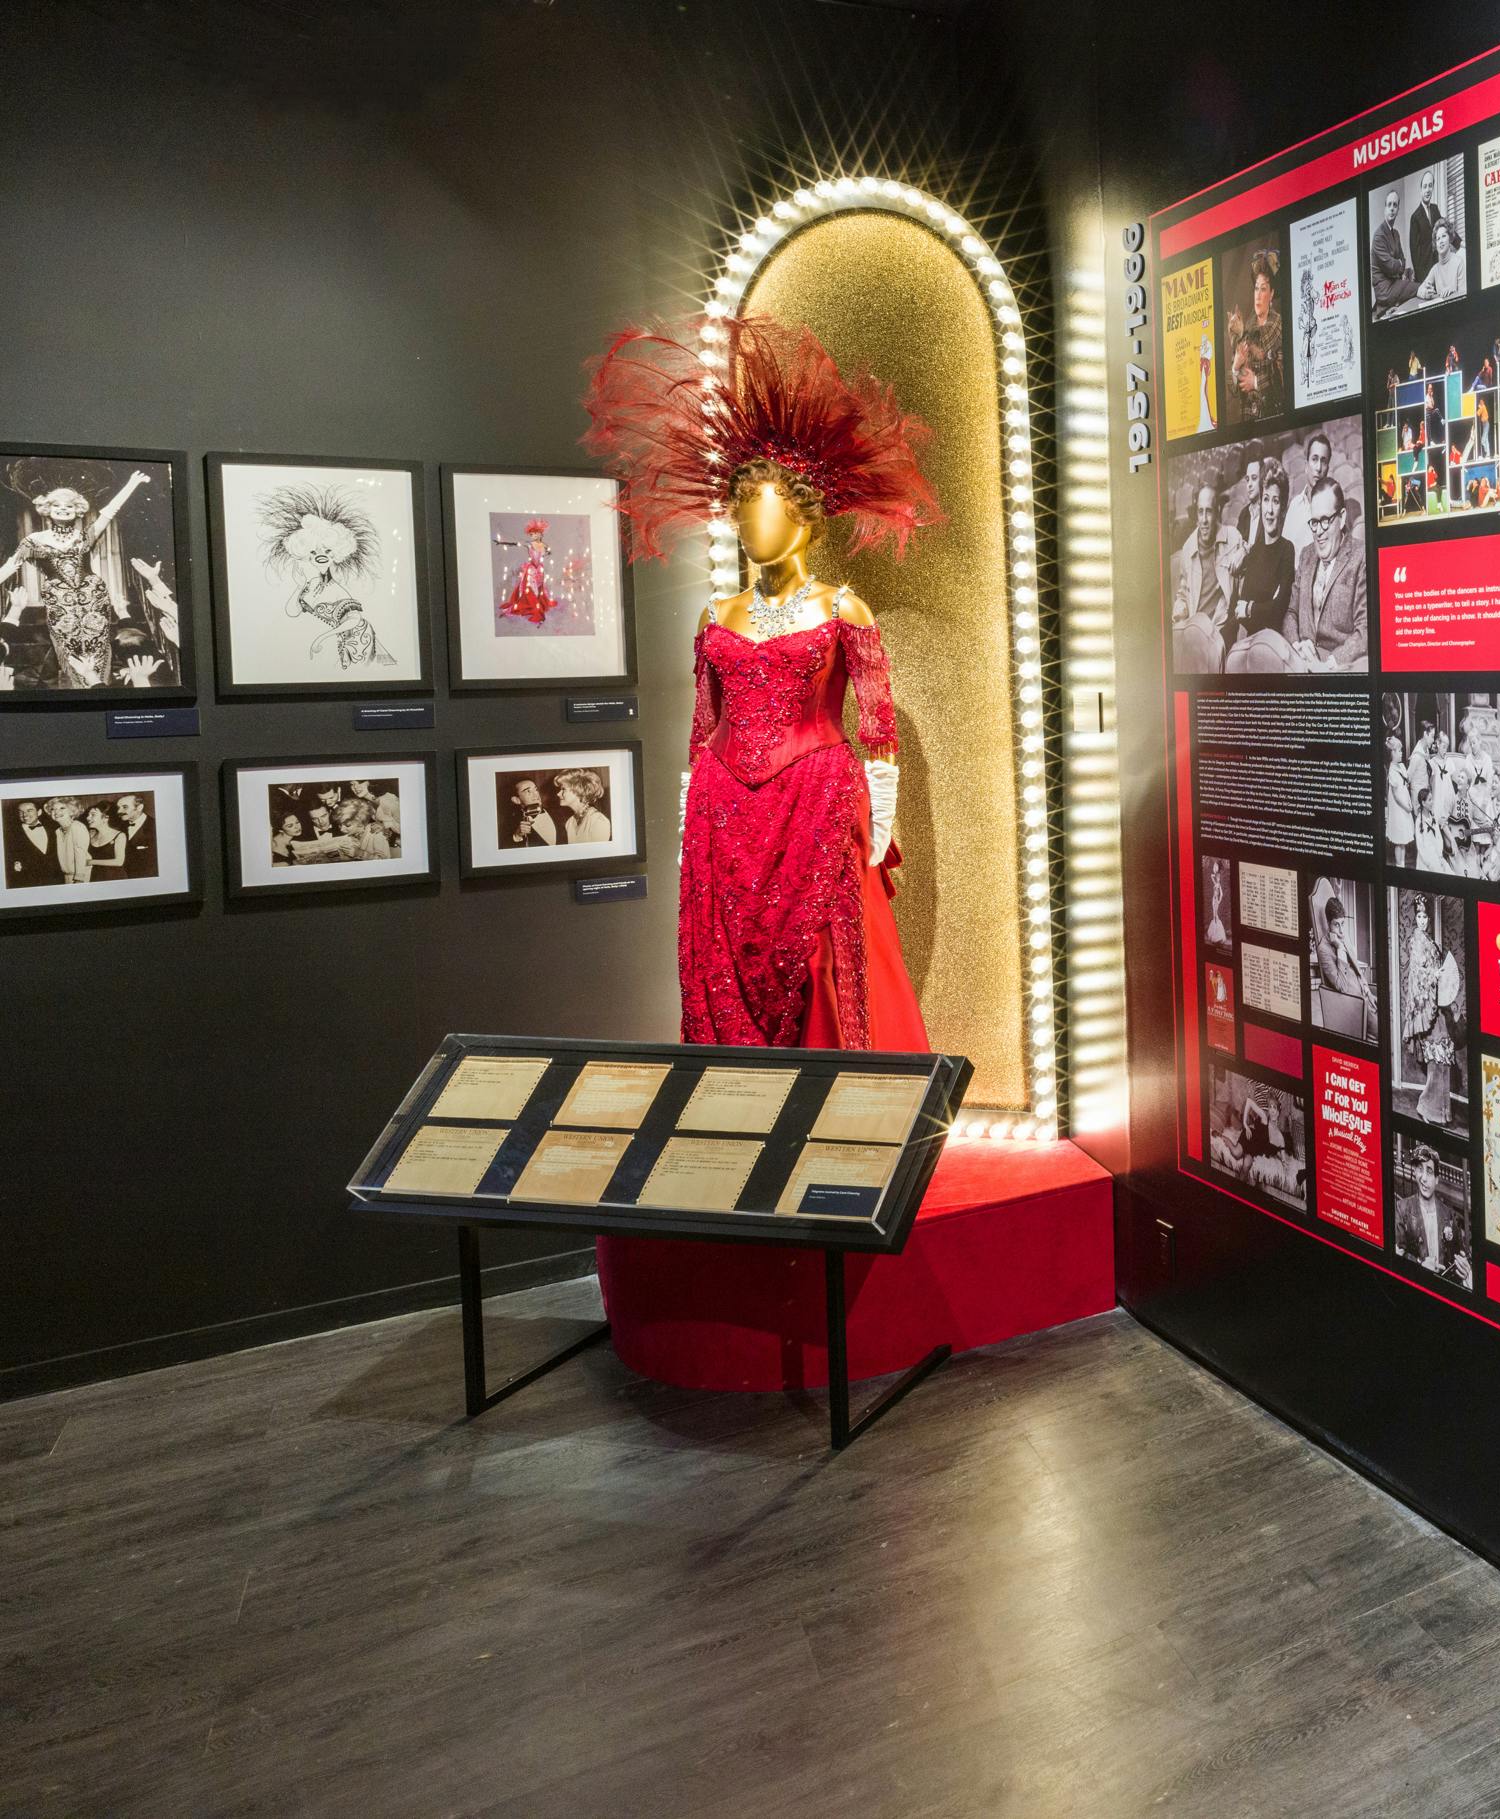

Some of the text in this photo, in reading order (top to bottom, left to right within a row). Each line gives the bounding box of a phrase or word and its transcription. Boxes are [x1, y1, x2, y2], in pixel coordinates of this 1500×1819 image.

[1353, 109, 1444, 168] MUSICALS
[1121, 222, 1148, 338] 1966
[1166, 312, 1183, 332] BEST
[1126, 361, 1152, 474] 1957
[1326, 1072, 1366, 1095] I CAN GET
[1334, 1092, 1350, 1108] FOR
[1322, 1104, 1372, 1135] WHOLESALE
